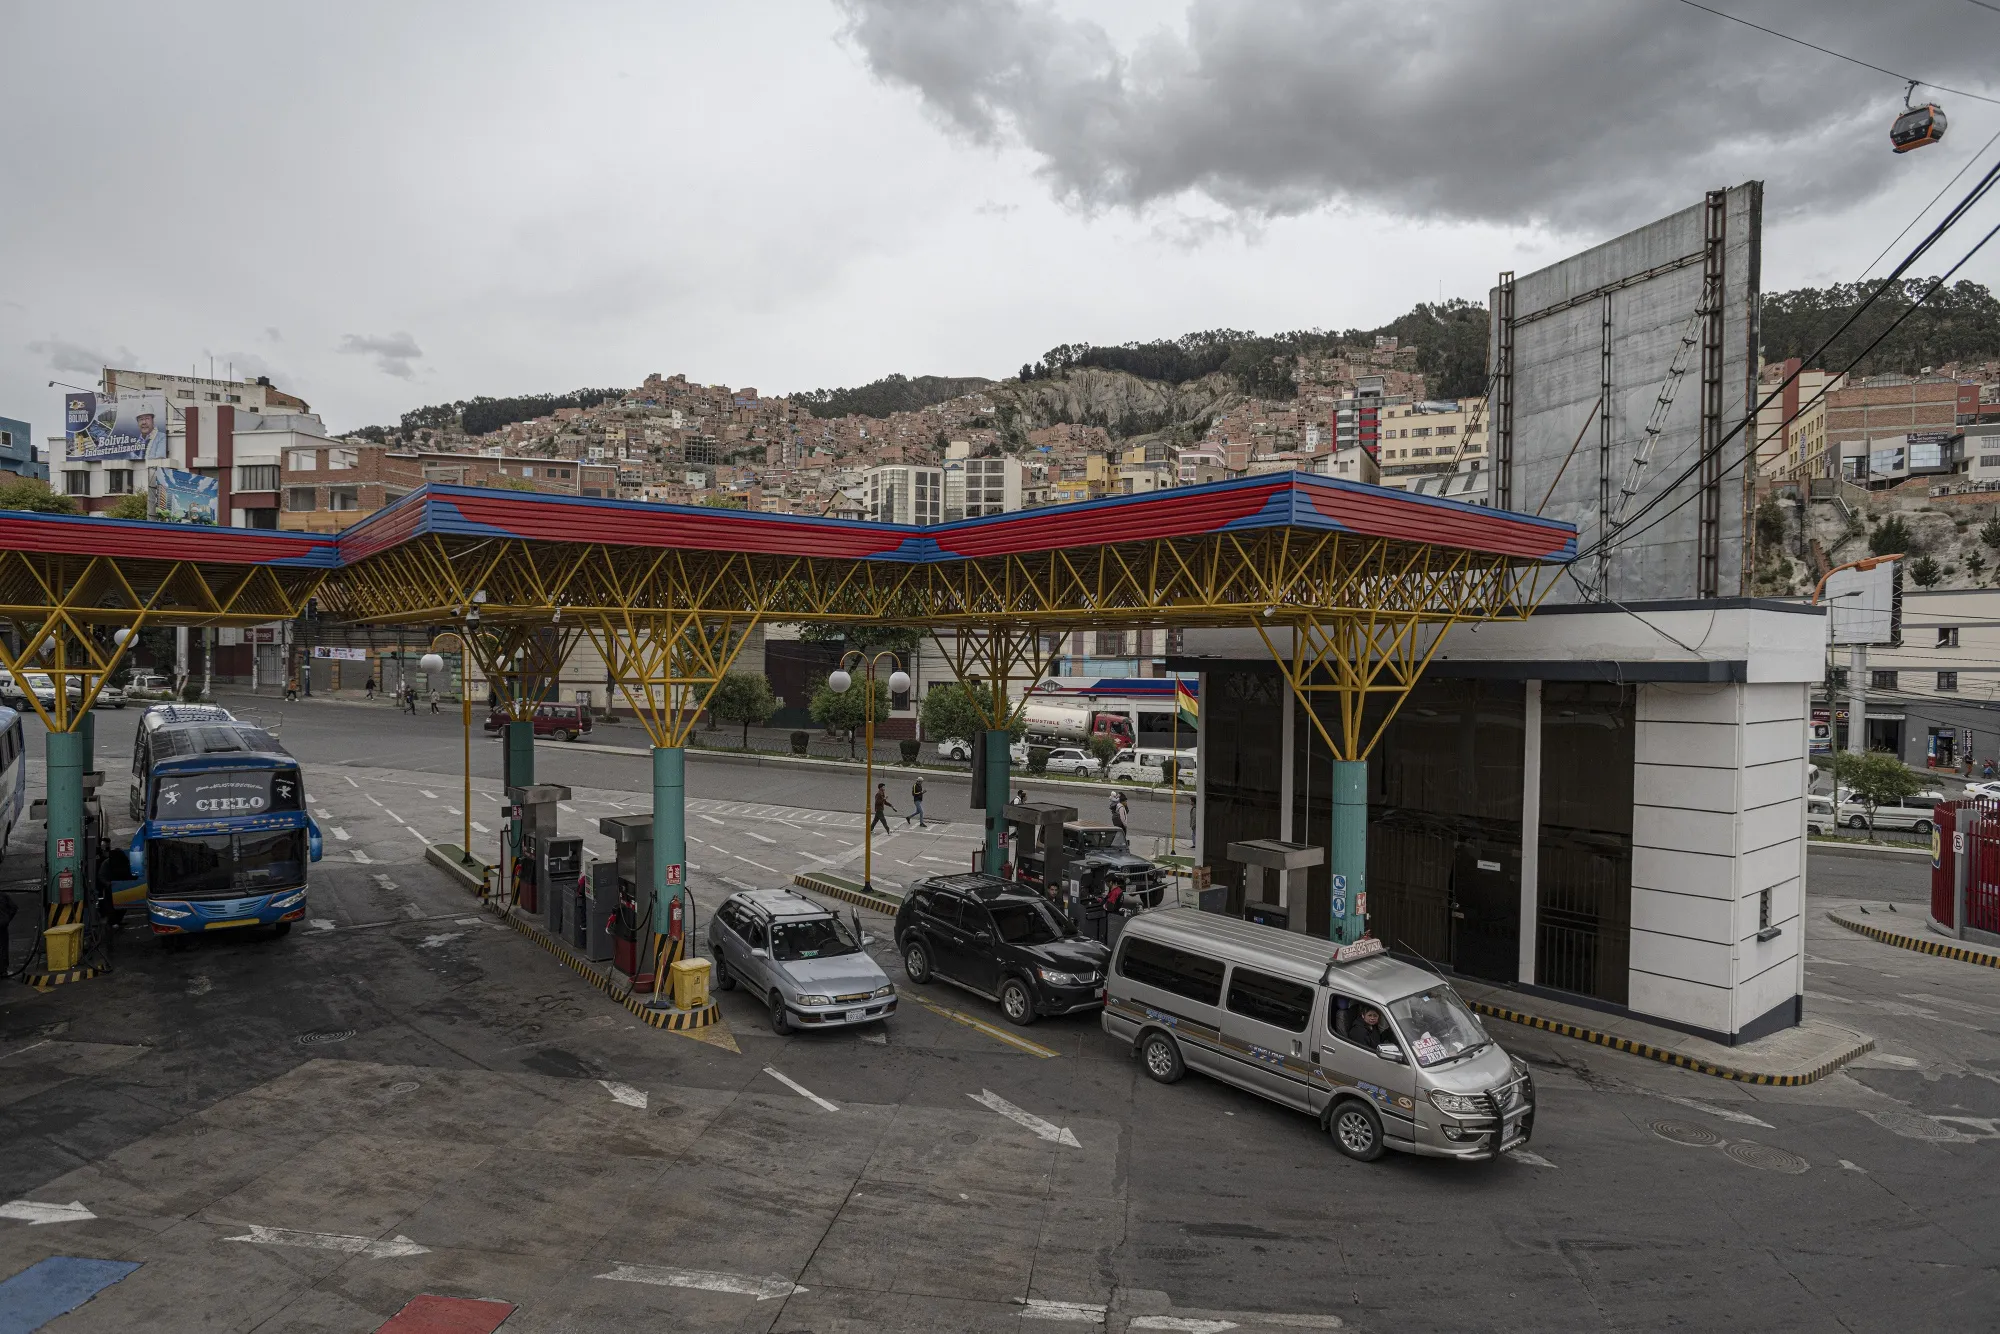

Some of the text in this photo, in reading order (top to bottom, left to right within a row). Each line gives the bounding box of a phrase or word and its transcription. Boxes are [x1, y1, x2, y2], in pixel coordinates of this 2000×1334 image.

[178, 377, 204, 385] RACKET
[69, 414, 88, 422] BOLIVIA
[99, 435, 129, 447] Bolivia
[1022, 717, 1060, 725] OMBUSTIBLE
[196, 797, 264, 811] CIELO
